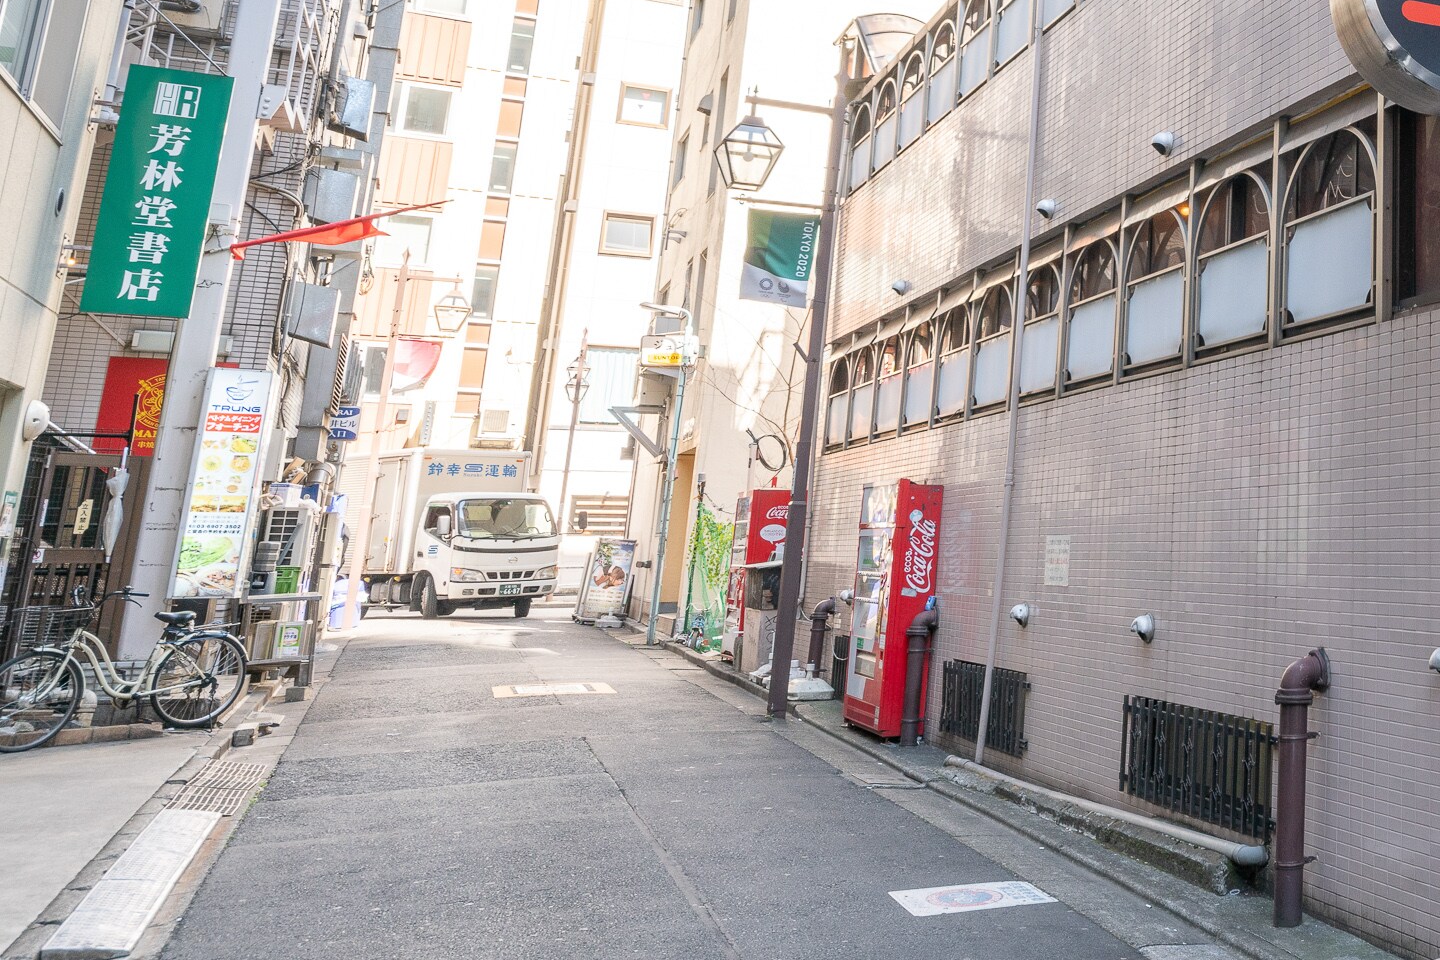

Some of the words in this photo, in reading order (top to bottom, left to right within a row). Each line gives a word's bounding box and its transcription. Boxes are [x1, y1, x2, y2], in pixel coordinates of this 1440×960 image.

[117, 123, 192, 302] 芳林堂書店
[800, 221, 815, 252] TOKYO
[795, 253, 809, 278] 2020
[212, 404, 261, 413] TRUNG
[208, 414, 261, 424] ベトナムダイニング
[330, 419, 357, 428] 井ビル
[206, 421, 260, 432] フォーチュン
